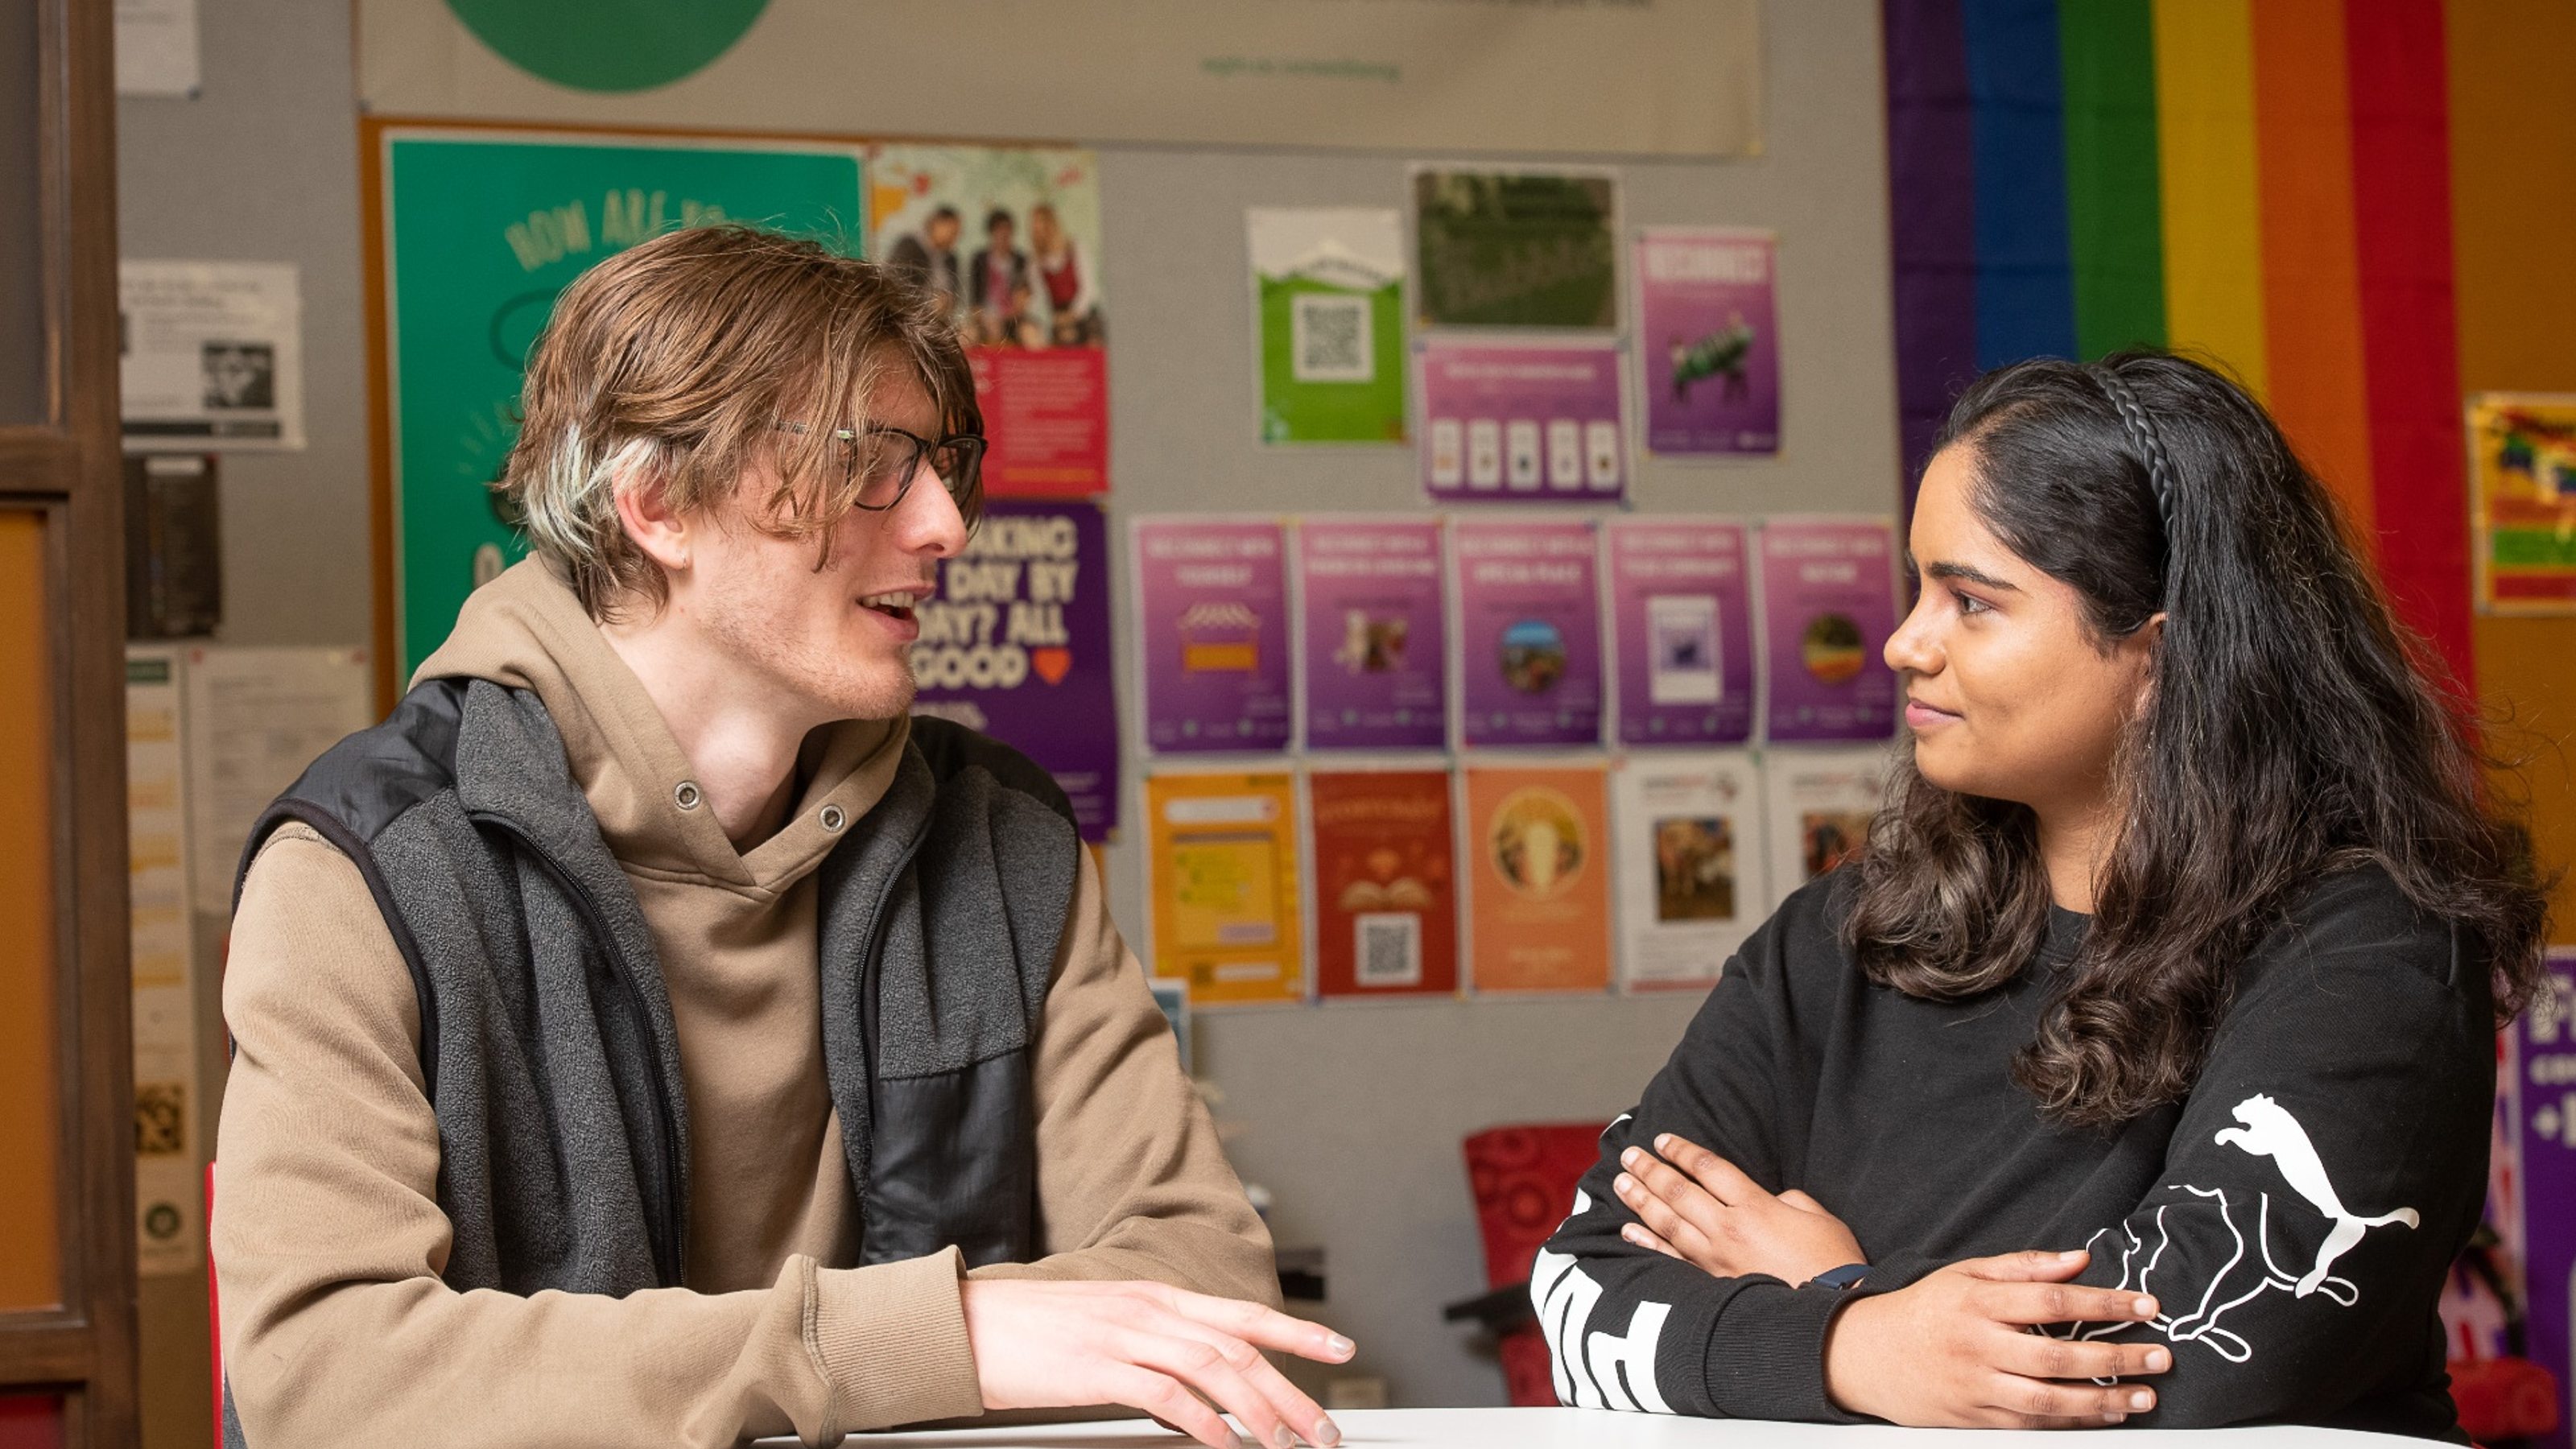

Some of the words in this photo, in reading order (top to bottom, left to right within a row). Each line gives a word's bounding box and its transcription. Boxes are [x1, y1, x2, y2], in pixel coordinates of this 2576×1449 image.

[964, 516, 1078, 559] AKING
[944, 562, 1022, 601] DAY
[1027, 562, 1079, 603] BY
[1006, 601, 1068, 646] ALL
[910, 644, 1029, 690] GOOD
